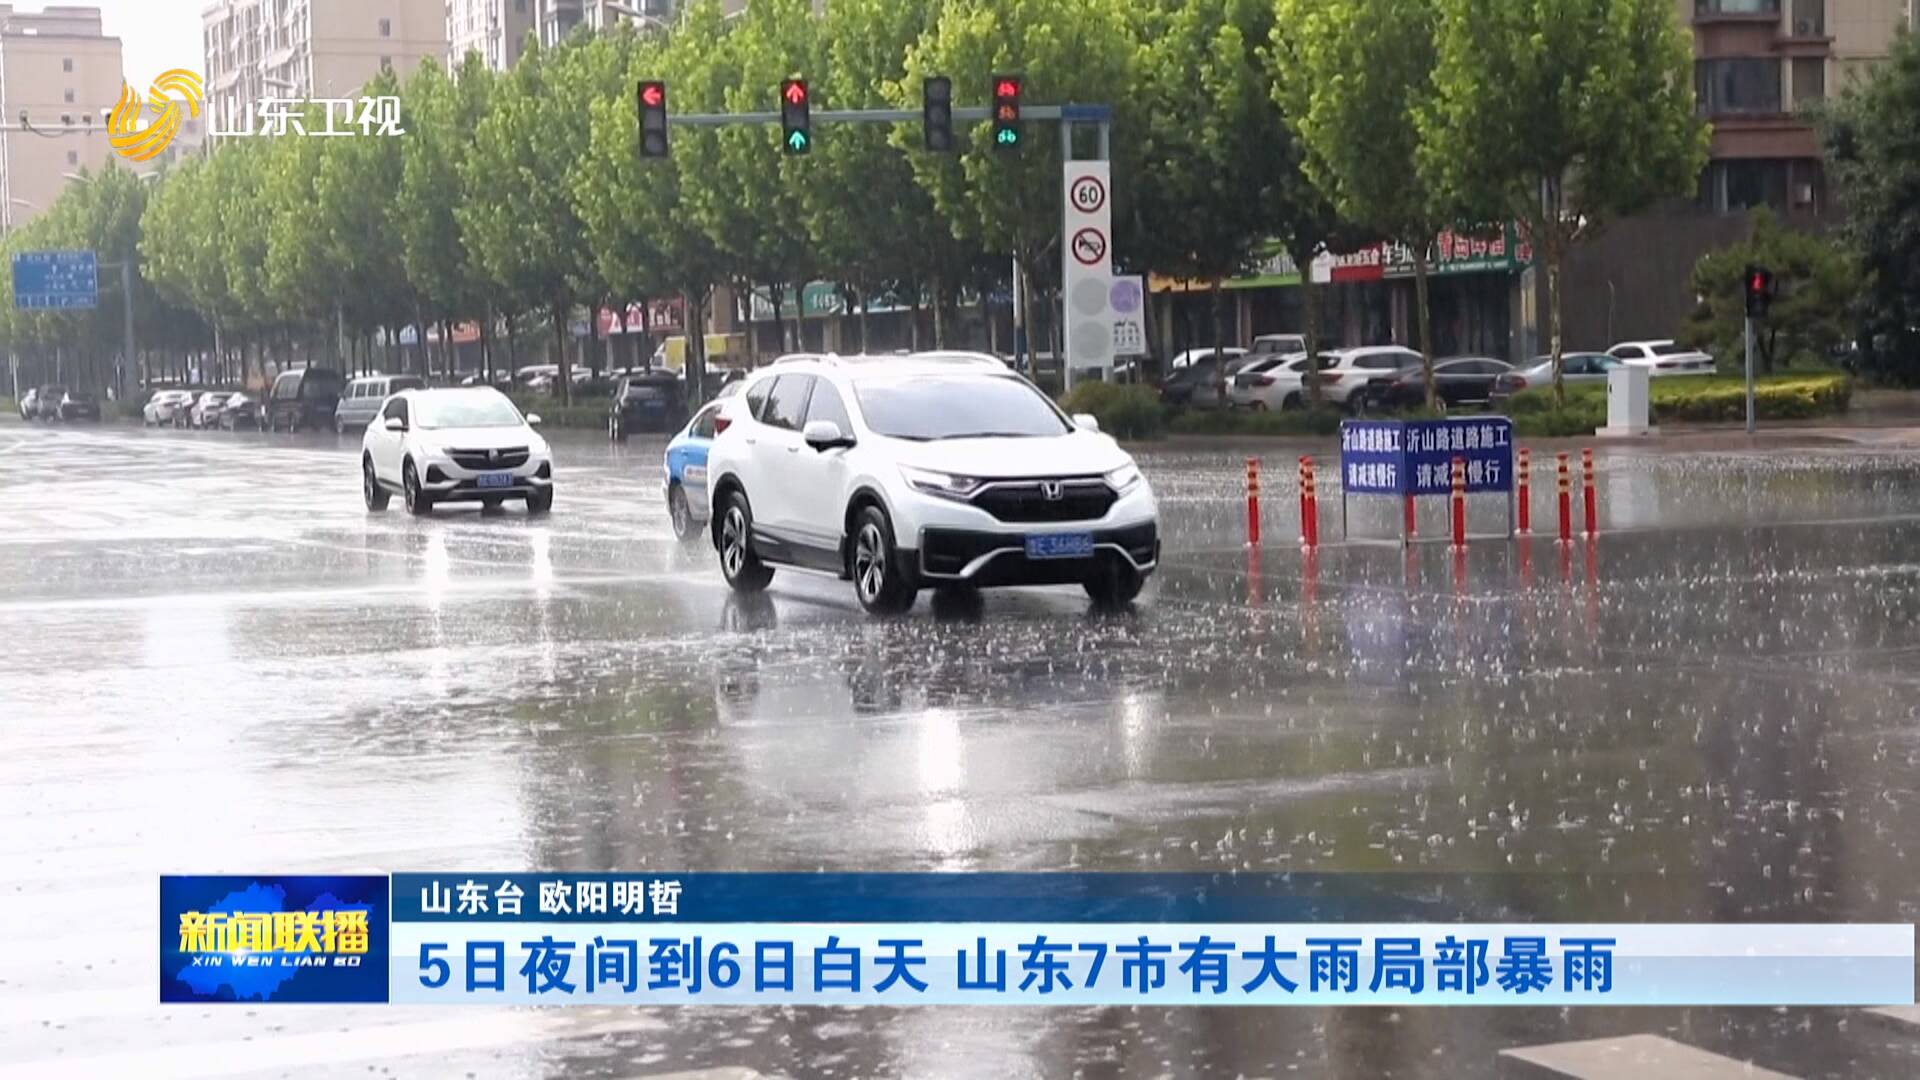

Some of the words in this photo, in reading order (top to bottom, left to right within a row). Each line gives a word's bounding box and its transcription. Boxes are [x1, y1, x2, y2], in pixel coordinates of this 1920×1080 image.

[1080, 186, 1098, 204] 60
[1342, 427, 1400, 452] 沂山路道路施工
[1406, 425, 1508, 453] 沂山路道路施工
[1348, 462, 1396, 487] 请减速慢行
[1416, 458, 1501, 487] 请减慢行
